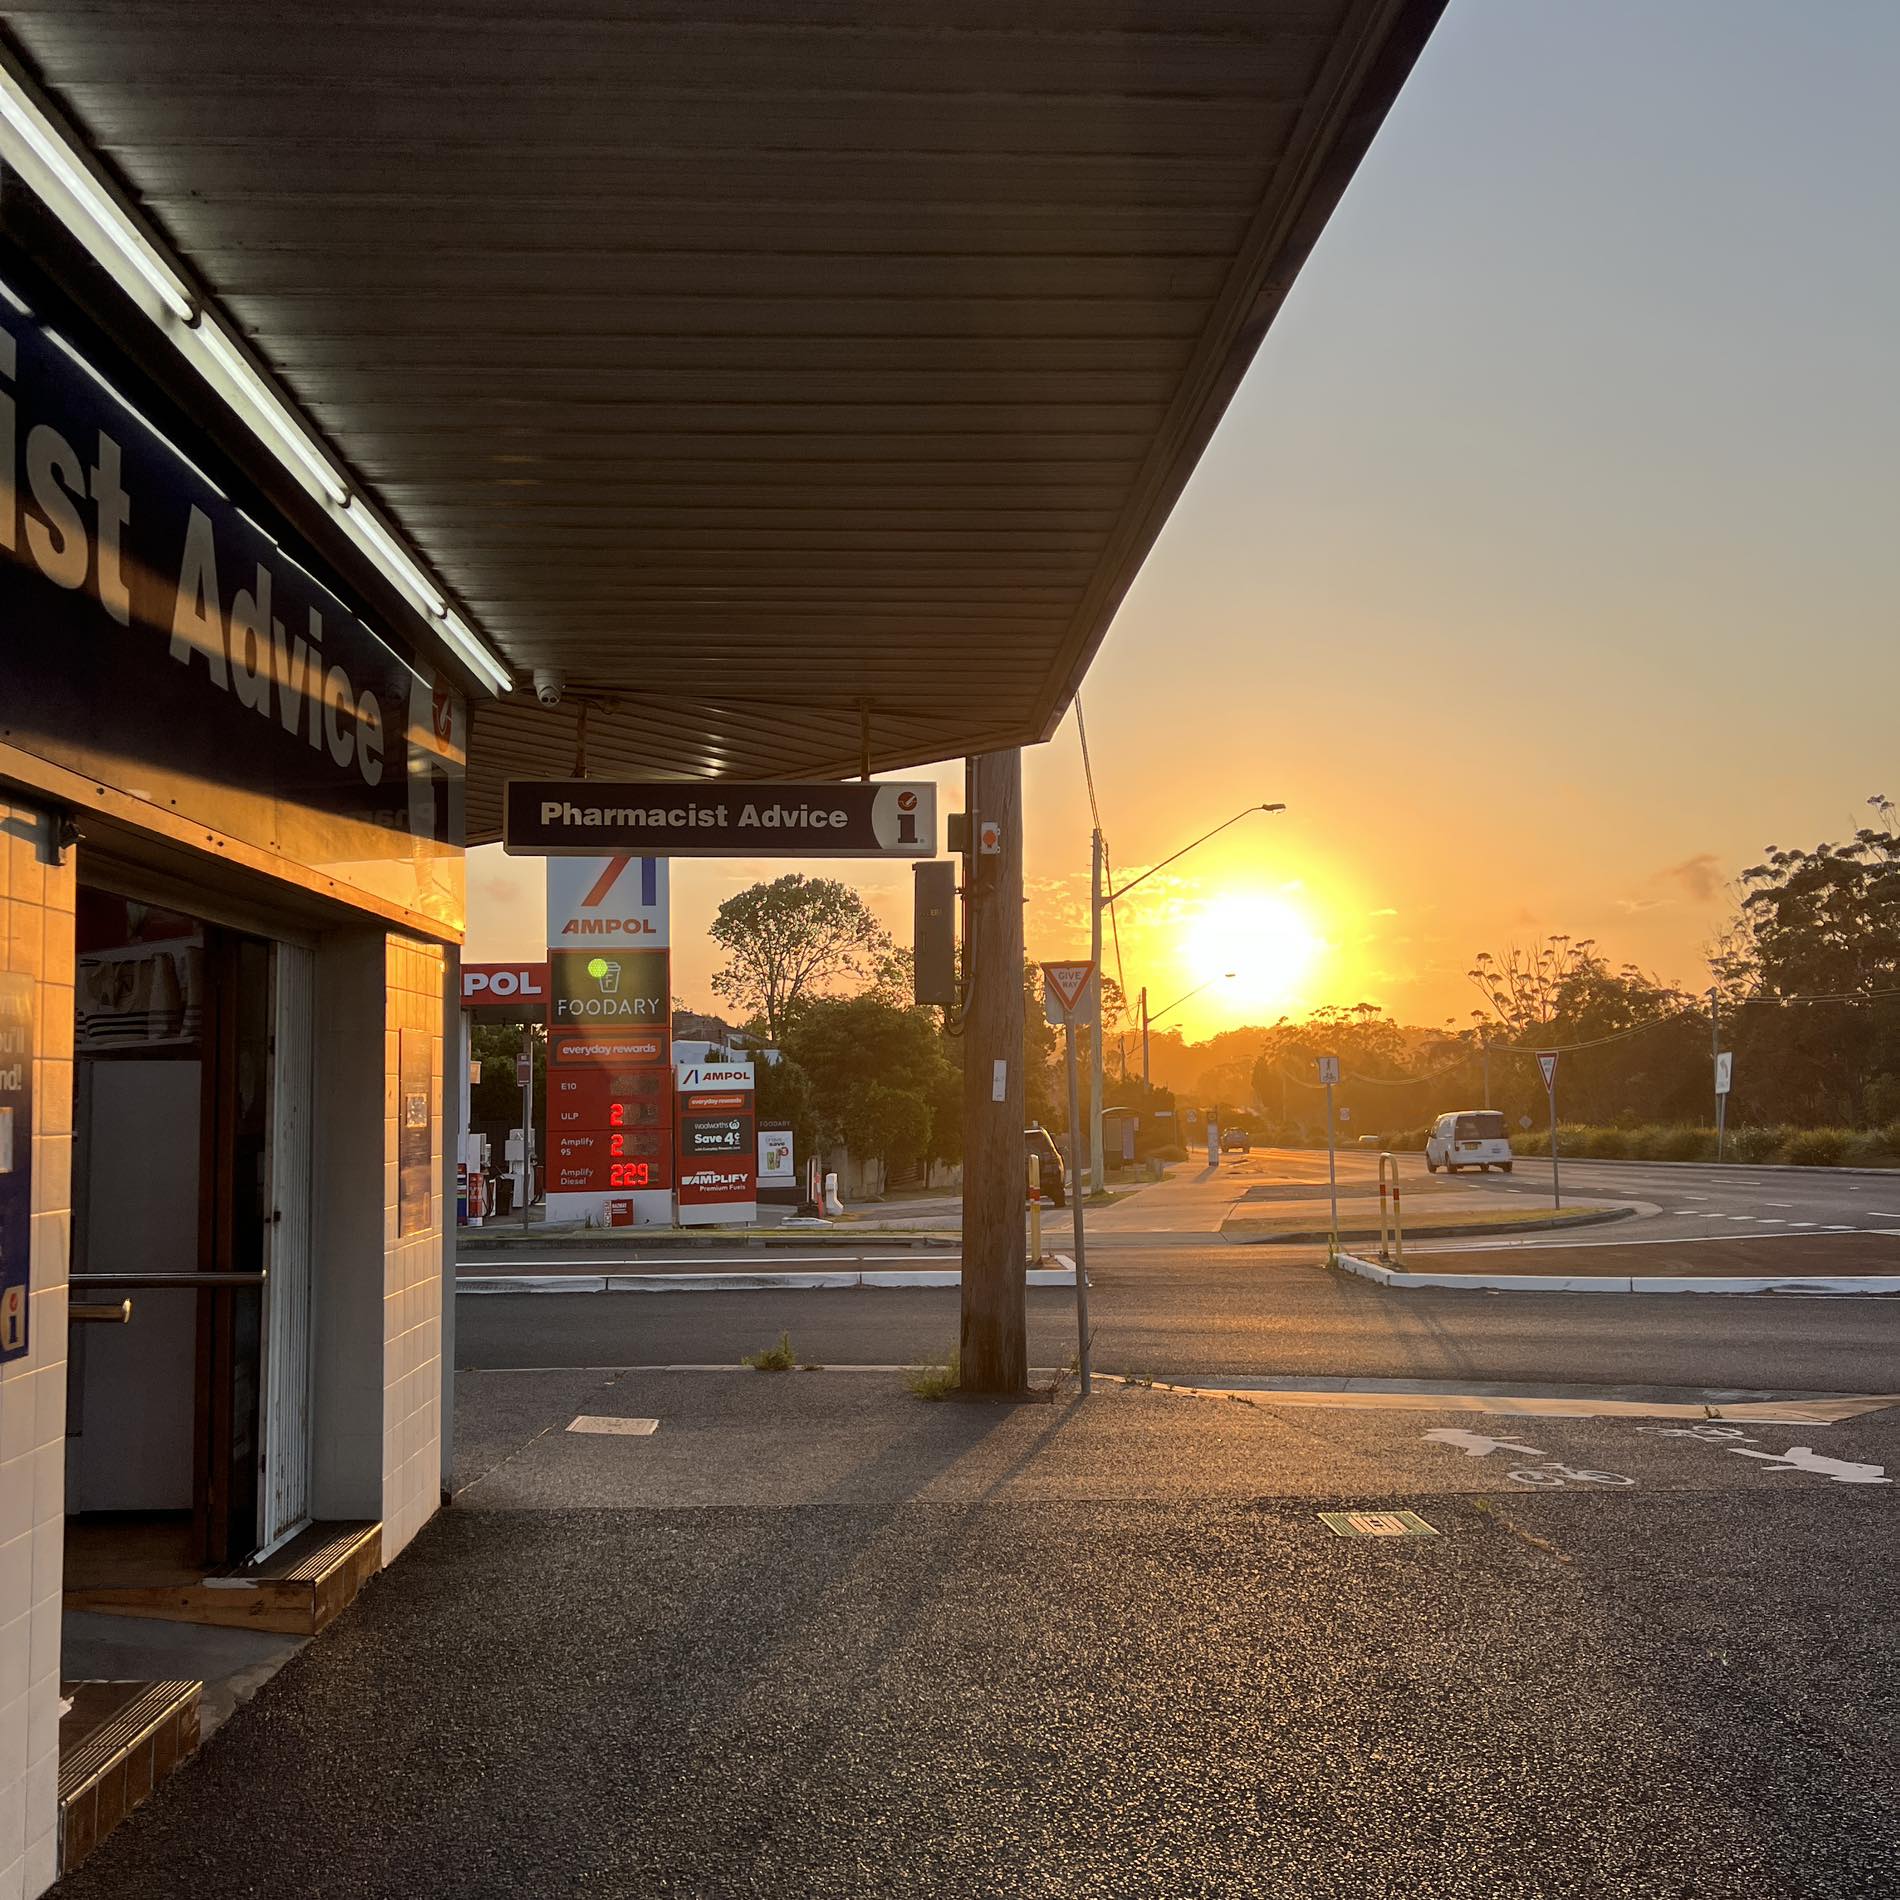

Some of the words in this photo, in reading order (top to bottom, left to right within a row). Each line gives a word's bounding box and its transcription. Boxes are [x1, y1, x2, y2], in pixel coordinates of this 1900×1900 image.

[169, 503, 385, 786] Advice
[540, 801, 728, 828] Pharmacist
[738, 801, 848, 828] Advice
[561, 919, 657, 935] AMPOL
[1058, 971, 1082, 980] GIVE
[463, 971, 542, 996] POL
[557, 998, 660, 1017] FOODARY
[562, 1045, 611, 1057] everyday
[613, 1043, 657, 1054] rewards
[703, 1072, 750, 1080] AMPOL
[561, 1112, 579, 1120] ULP
[609, 1103, 624, 1127] 2
[560, 1137, 594, 1147] Amplify
[560, 1148, 571, 1156] 95
[610, 1133, 624, 1157] 2
[694, 1133, 723, 1144] Save
[560, 1168, 594, 1178] Amplify
[610, 1163, 649, 1187] 229
[560, 1177, 587, 1185] Diesel
[691, 1174, 748, 1185] AMPLIFY
[699, 1182, 728, 1192] Premium
